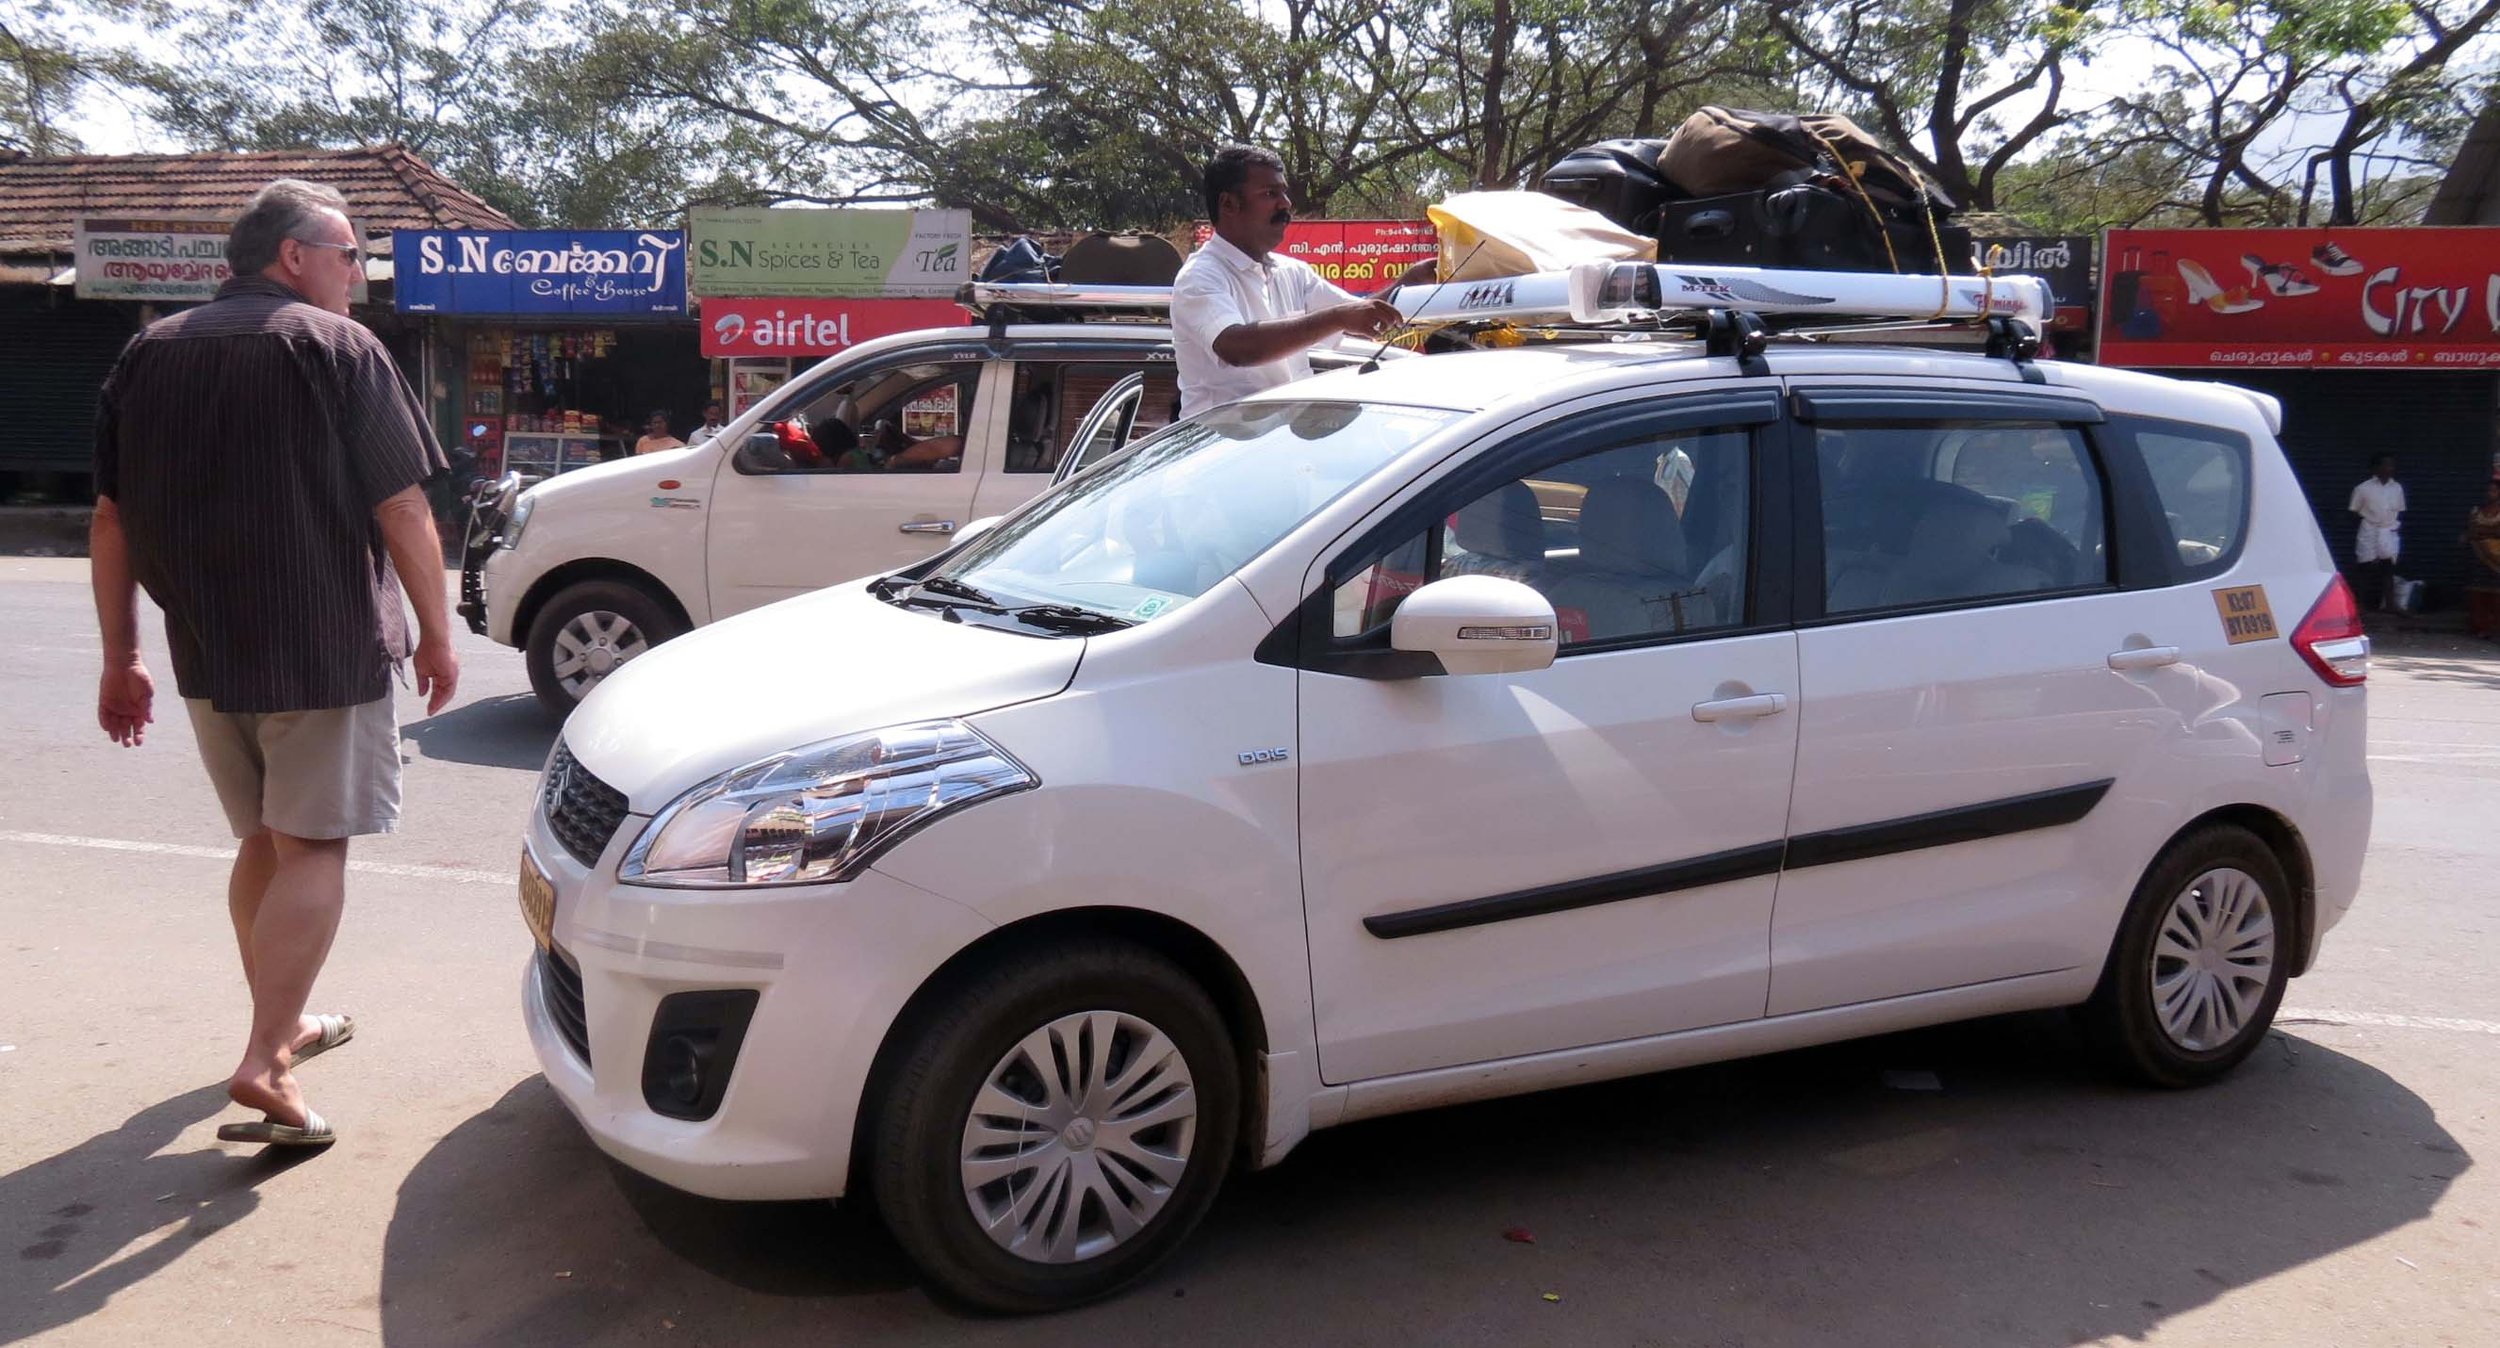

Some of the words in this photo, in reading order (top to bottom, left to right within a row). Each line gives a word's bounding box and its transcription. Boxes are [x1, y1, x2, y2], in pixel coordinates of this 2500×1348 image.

[420, 235, 490, 275] S.N
[492, 233, 681, 292] ബേക്കറി
[700, 239, 755, 268] S.N
[758, 250, 821, 272] Spices
[827, 251, 844, 269] &
[849, 251, 880, 269] Tea
[916, 248, 957, 272] Tea
[531, 279, 590, 301] Coffee
[595, 279, 647, 300] House
[1681, 284, 1731, 293] M-TEK
[752, 310, 851, 346] airtel
[1146, 352, 1177, 362] XYL
[2338, 351, 2409, 365] കുടകൾ
